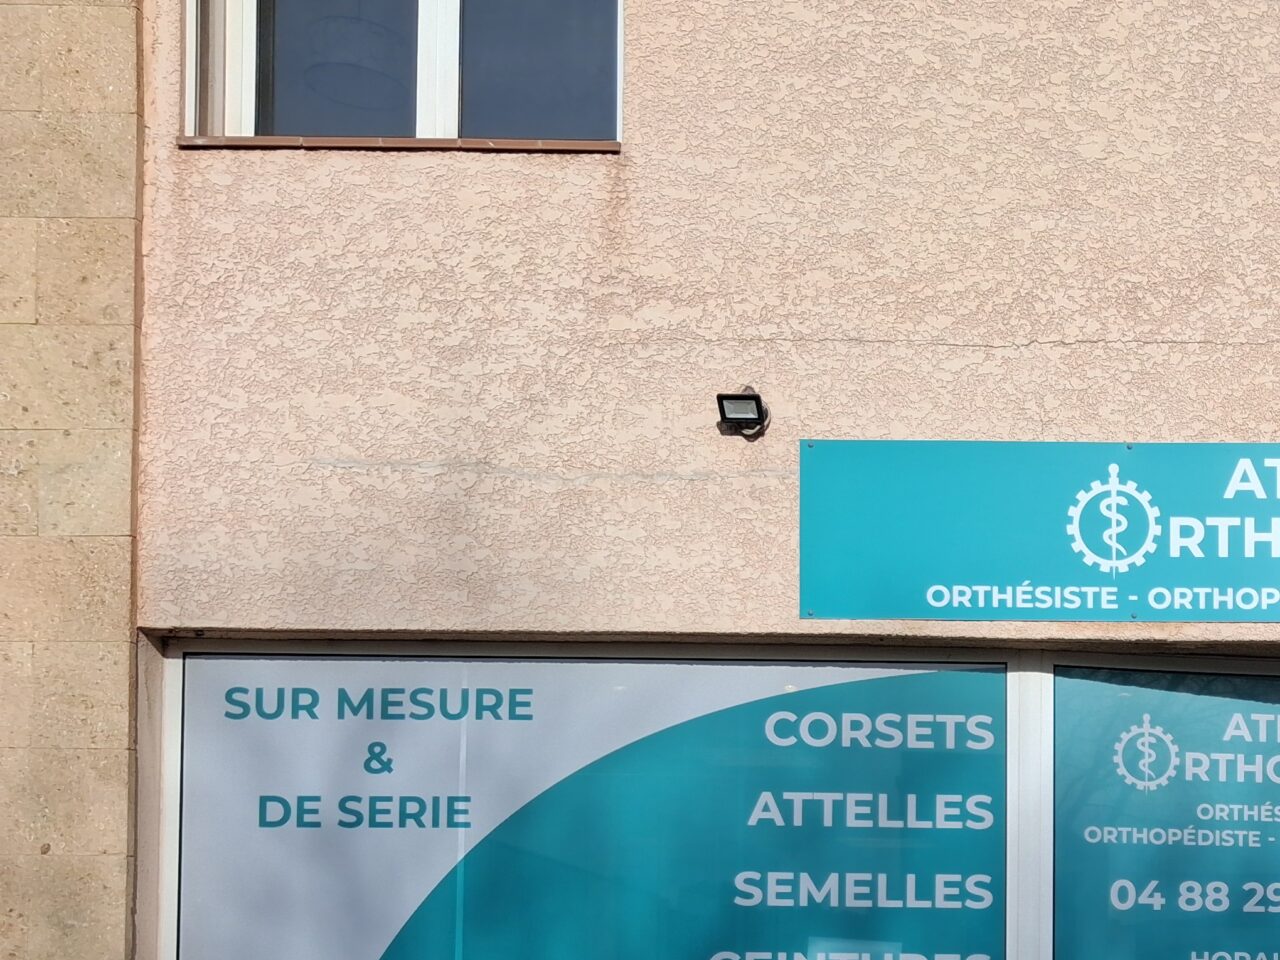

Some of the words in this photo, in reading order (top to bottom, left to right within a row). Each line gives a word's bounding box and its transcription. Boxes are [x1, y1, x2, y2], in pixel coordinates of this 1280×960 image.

[926, 580, 1119, 610] ORTHÉSISTE
[224, 686, 320, 721] SUR
[337, 687, 534, 721] MESURE
[764, 710, 995, 750] CORSETS
[363, 741, 394, 775] &
[258, 795, 322, 829] DE
[337, 795, 472, 829] SERIE
[747, 791, 994, 830] ATTELLES
[1083, 824, 1261, 848] ORTHOPÉDISTE
[734, 870, 994, 910] SEMELLES
[1109, 878, 1166, 911] 04
[1177, 880, 1230, 913] 88
